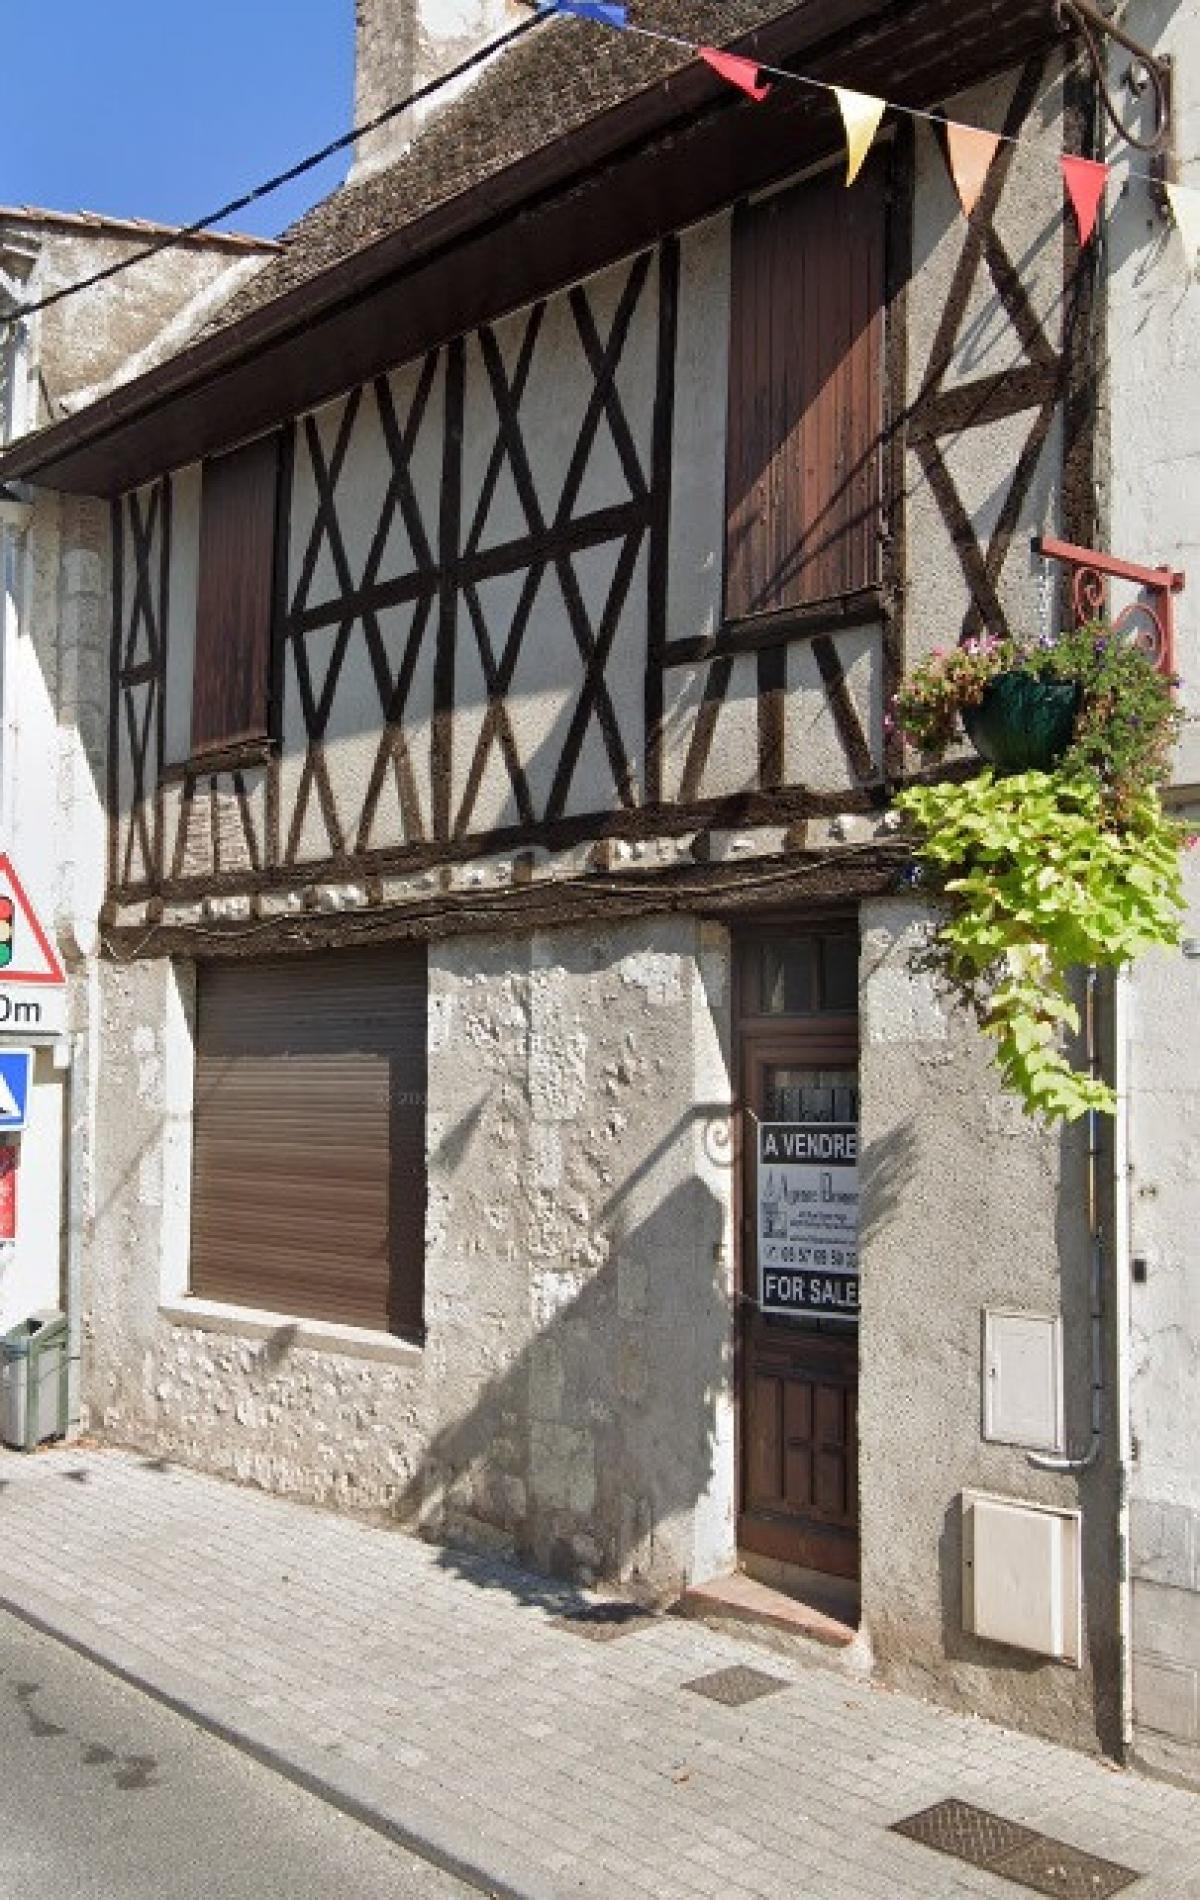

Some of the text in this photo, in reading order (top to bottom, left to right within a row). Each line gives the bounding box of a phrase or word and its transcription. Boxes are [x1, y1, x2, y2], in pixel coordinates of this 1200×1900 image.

[764, 1133, 857, 1158] A VENDRE
[766, 1275, 857, 1306] FOR SALE
